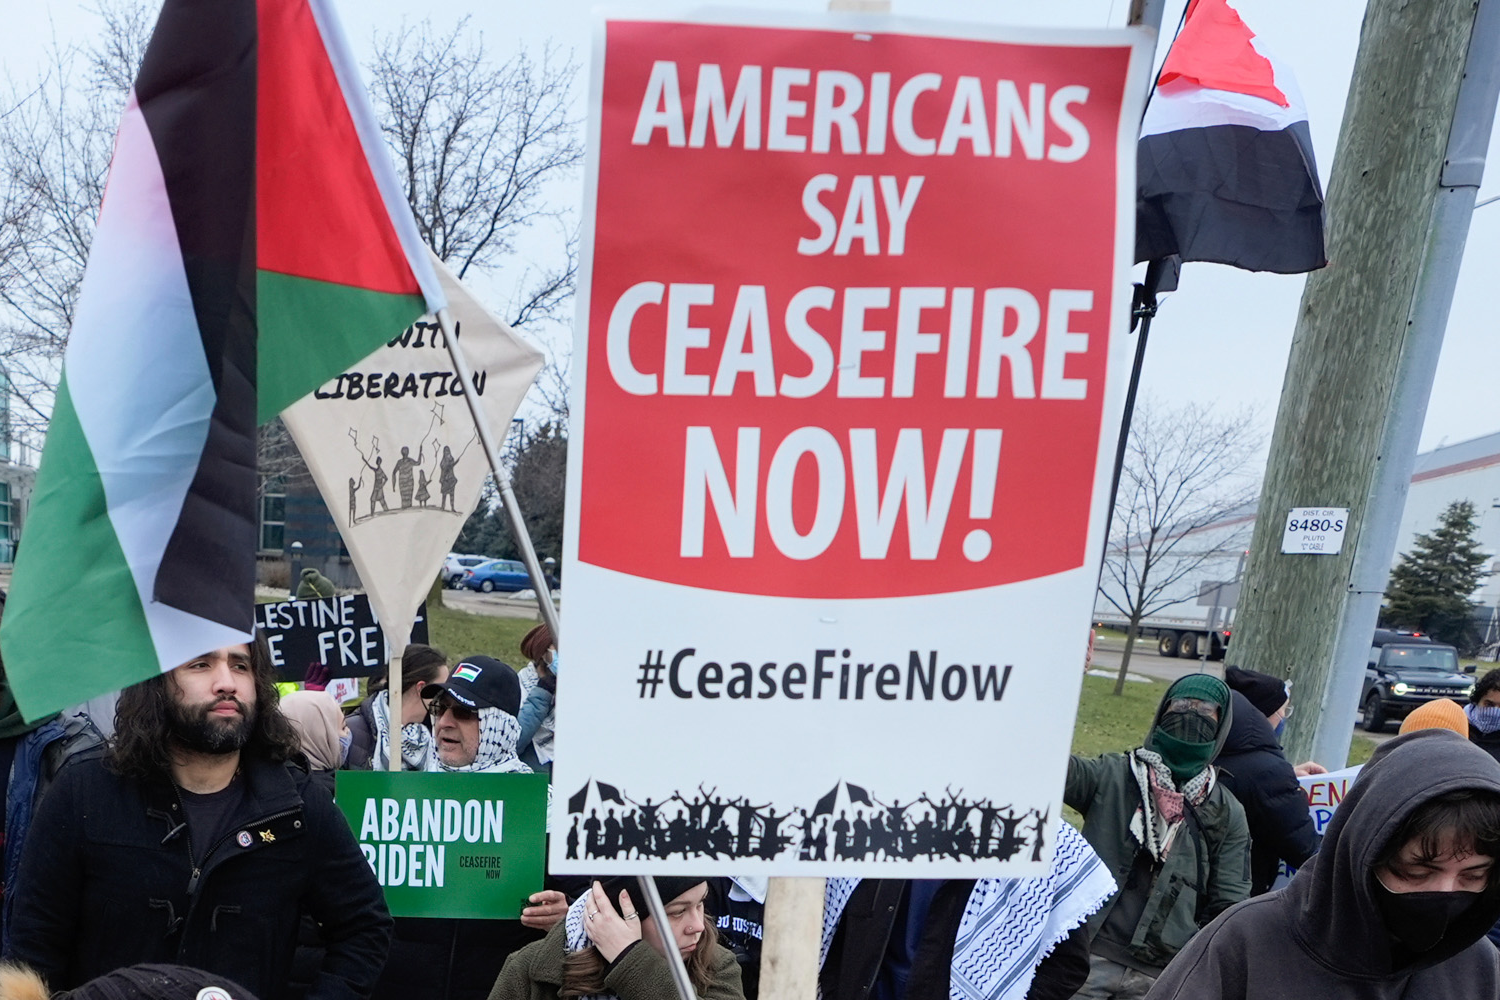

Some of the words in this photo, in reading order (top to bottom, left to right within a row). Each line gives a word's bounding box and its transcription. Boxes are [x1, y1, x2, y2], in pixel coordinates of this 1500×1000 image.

[631, 60, 1091, 164] AMERICANS
[797, 172, 925, 256] SAY
[606, 281, 1094, 400] CEASEFIRE
[680, 425, 1002, 563] NOW!
[1288, 519, 1344, 532] 8480-S
[255, 595, 355, 630] LESTINE
[637, 647, 1013, 702] #CeaseFireNow
[359, 798, 504, 843] ABANDON
[459, 856, 501, 869] CEASEFIRE
[485, 869, 501, 880] NOW
